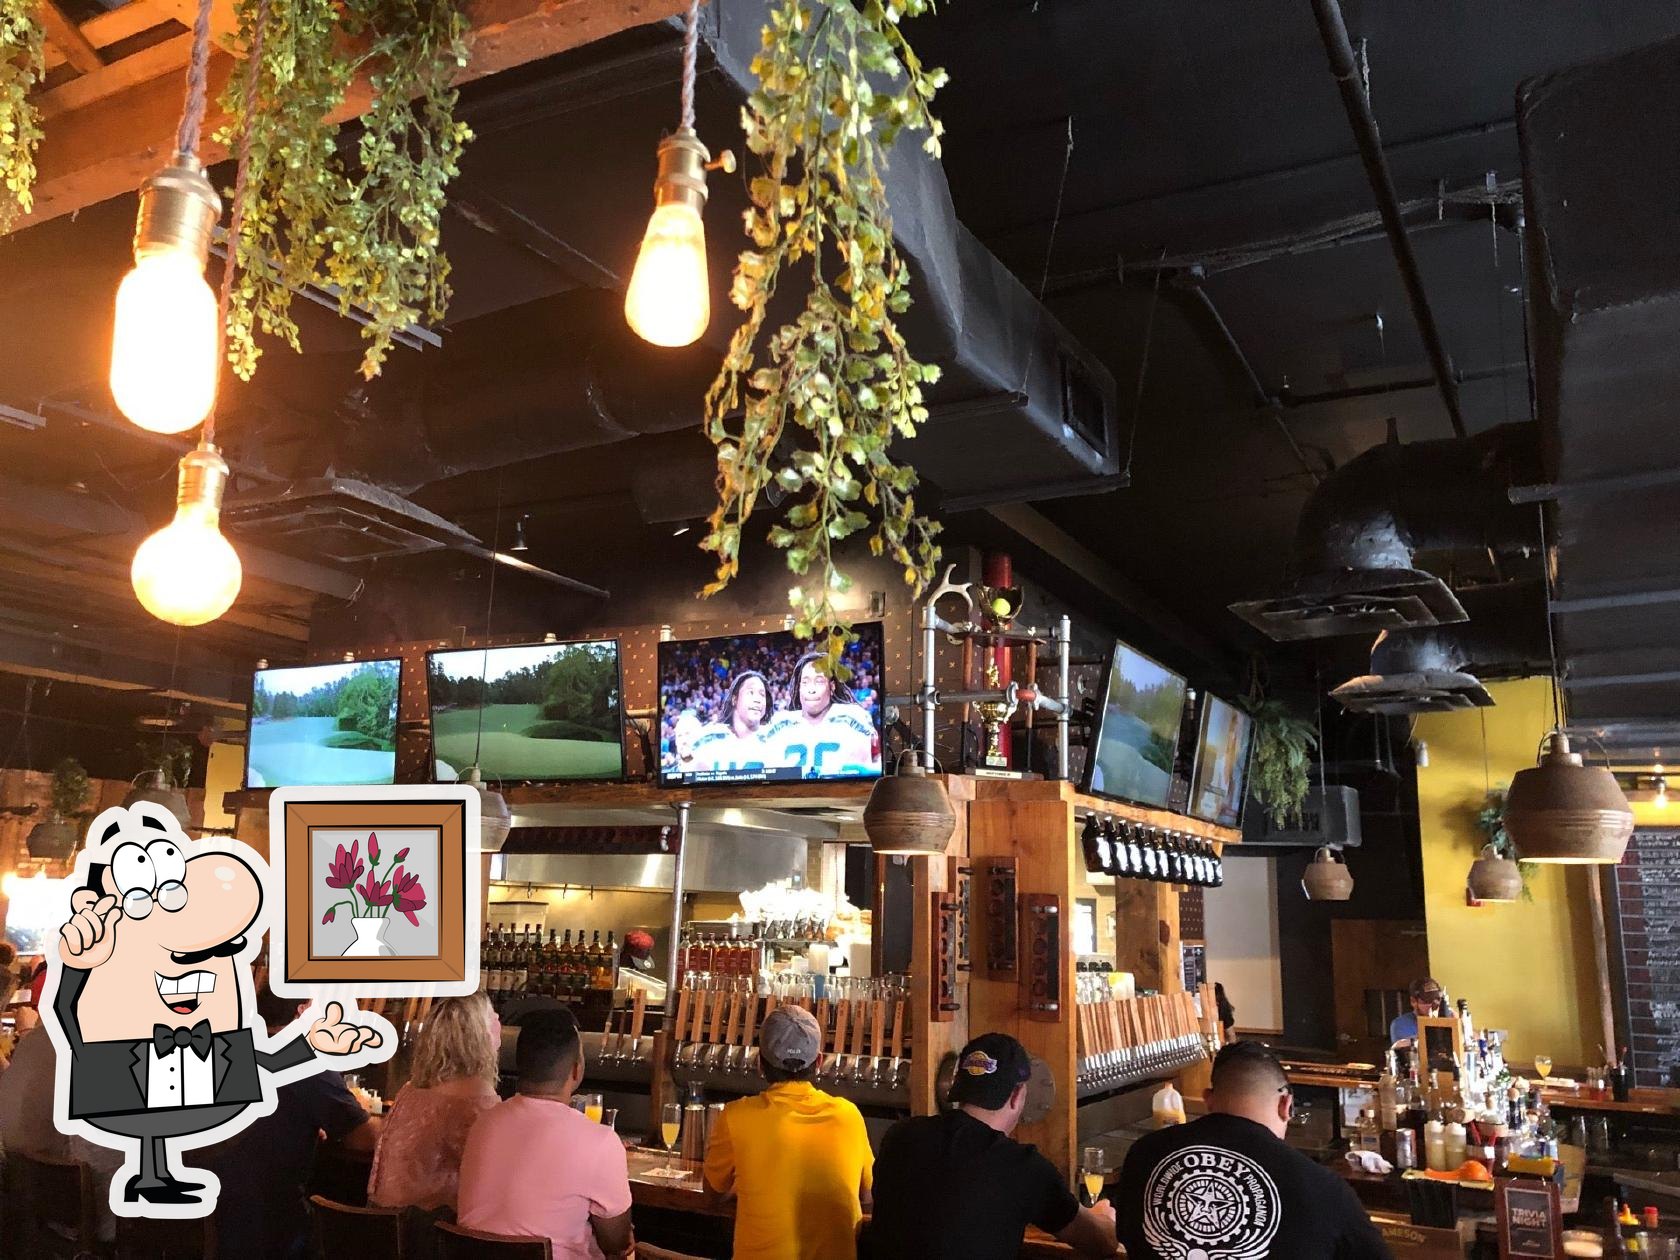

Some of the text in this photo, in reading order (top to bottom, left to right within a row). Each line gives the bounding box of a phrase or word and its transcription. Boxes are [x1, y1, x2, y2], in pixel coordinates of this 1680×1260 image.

[1183, 1153, 1249, 1178] OBEY
[1152, 1161, 1185, 1206] WORLDWIDE
[1511, 1207, 1547, 1218] TRIVIA
[1512, 1216, 1547, 1227] NIGHT
